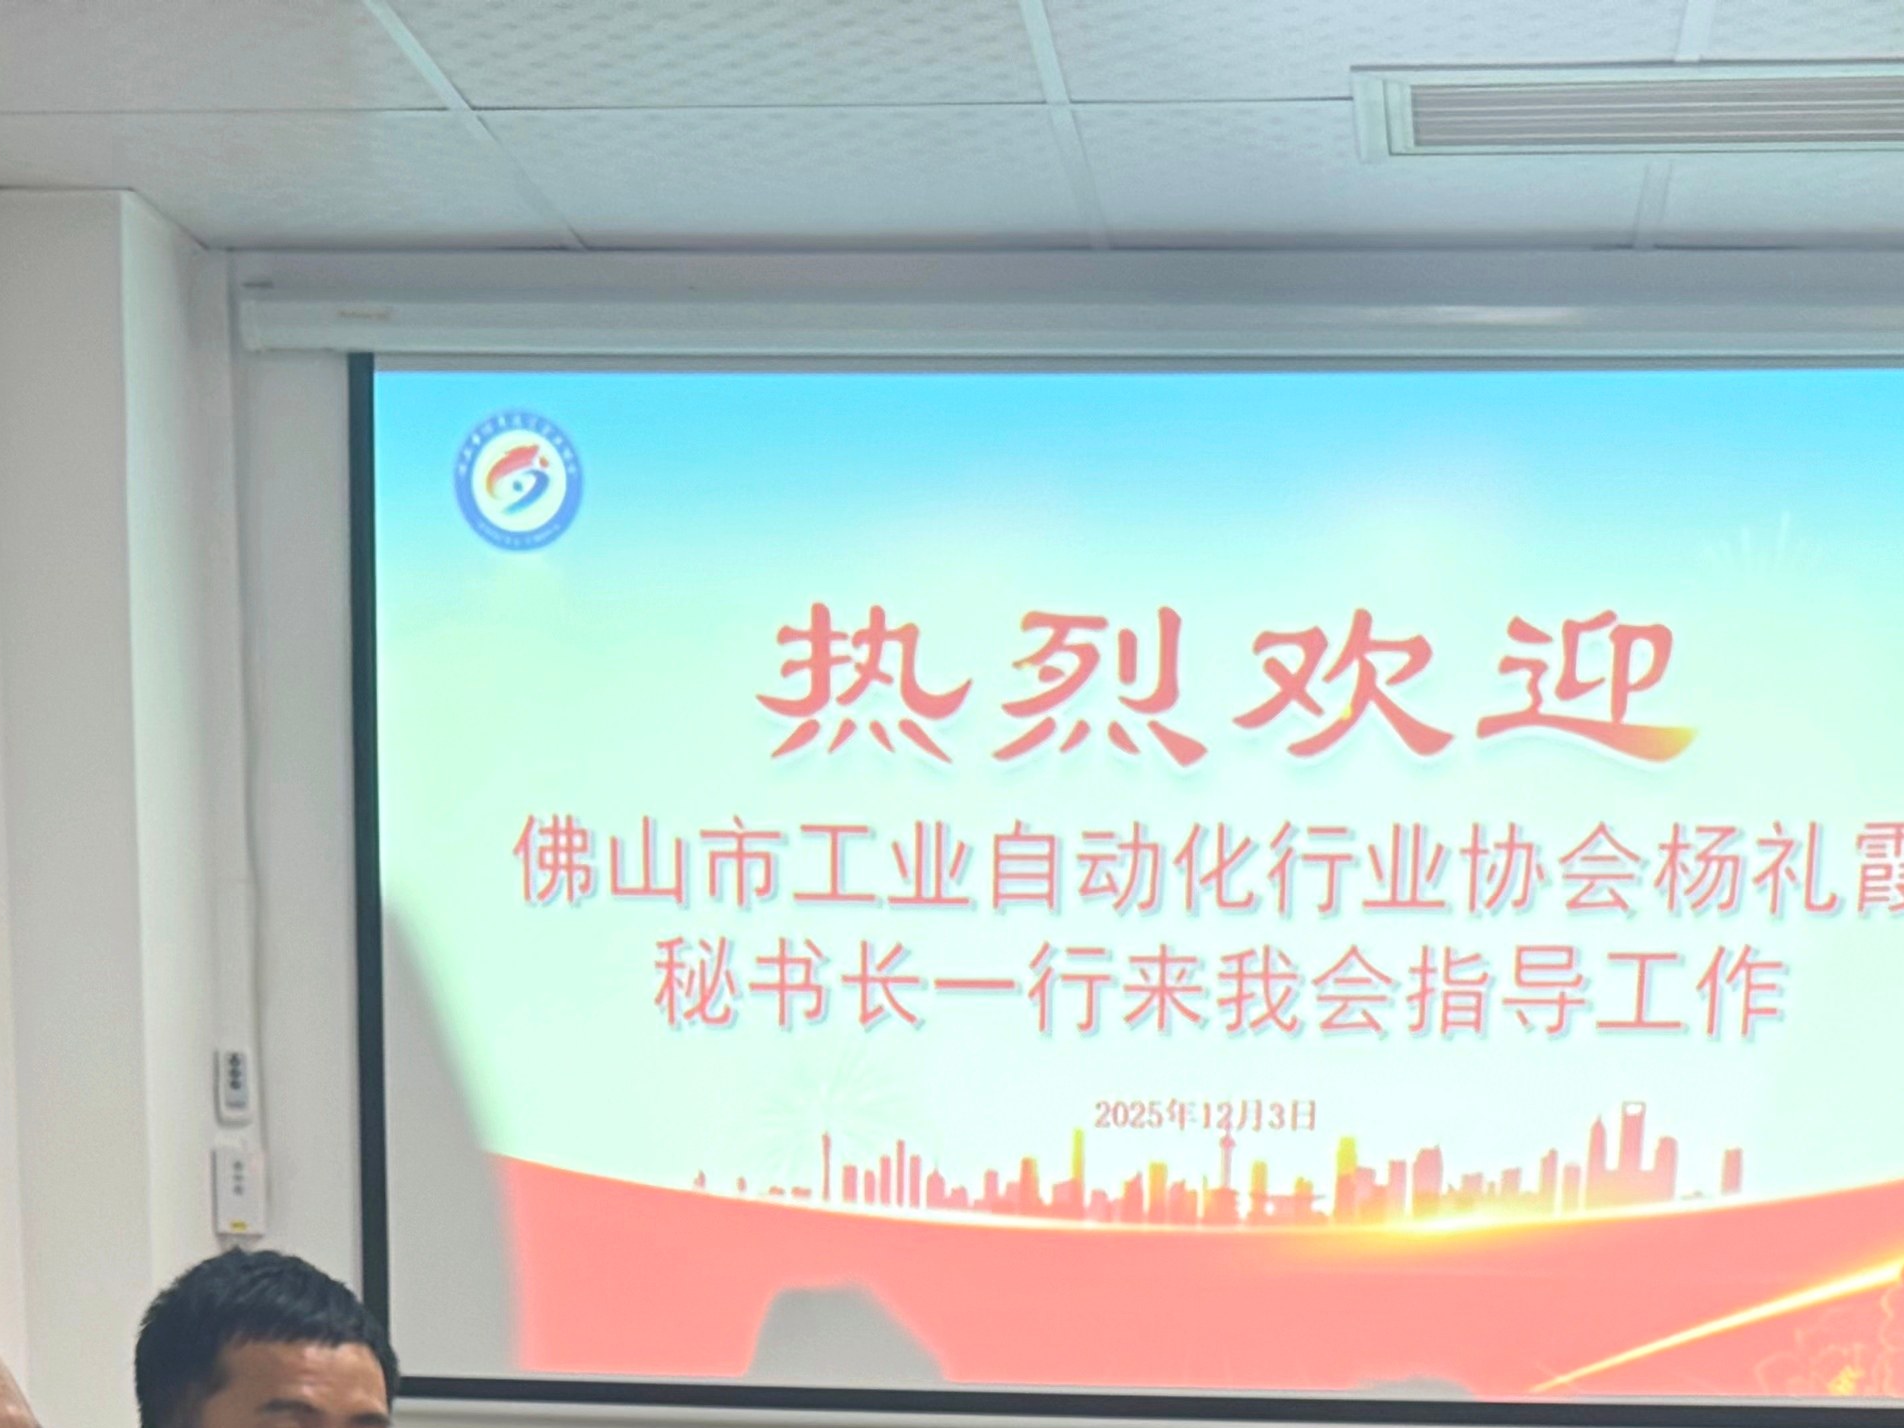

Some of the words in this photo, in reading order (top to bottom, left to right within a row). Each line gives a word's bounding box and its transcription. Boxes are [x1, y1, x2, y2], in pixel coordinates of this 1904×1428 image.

[756, 602, 1698, 766] 热烈欢迎
[654, 934, 1786, 1038] 秘书长一行来我会指导工作
[1094, 1098, 1316, 1132] 2025年12月3日
